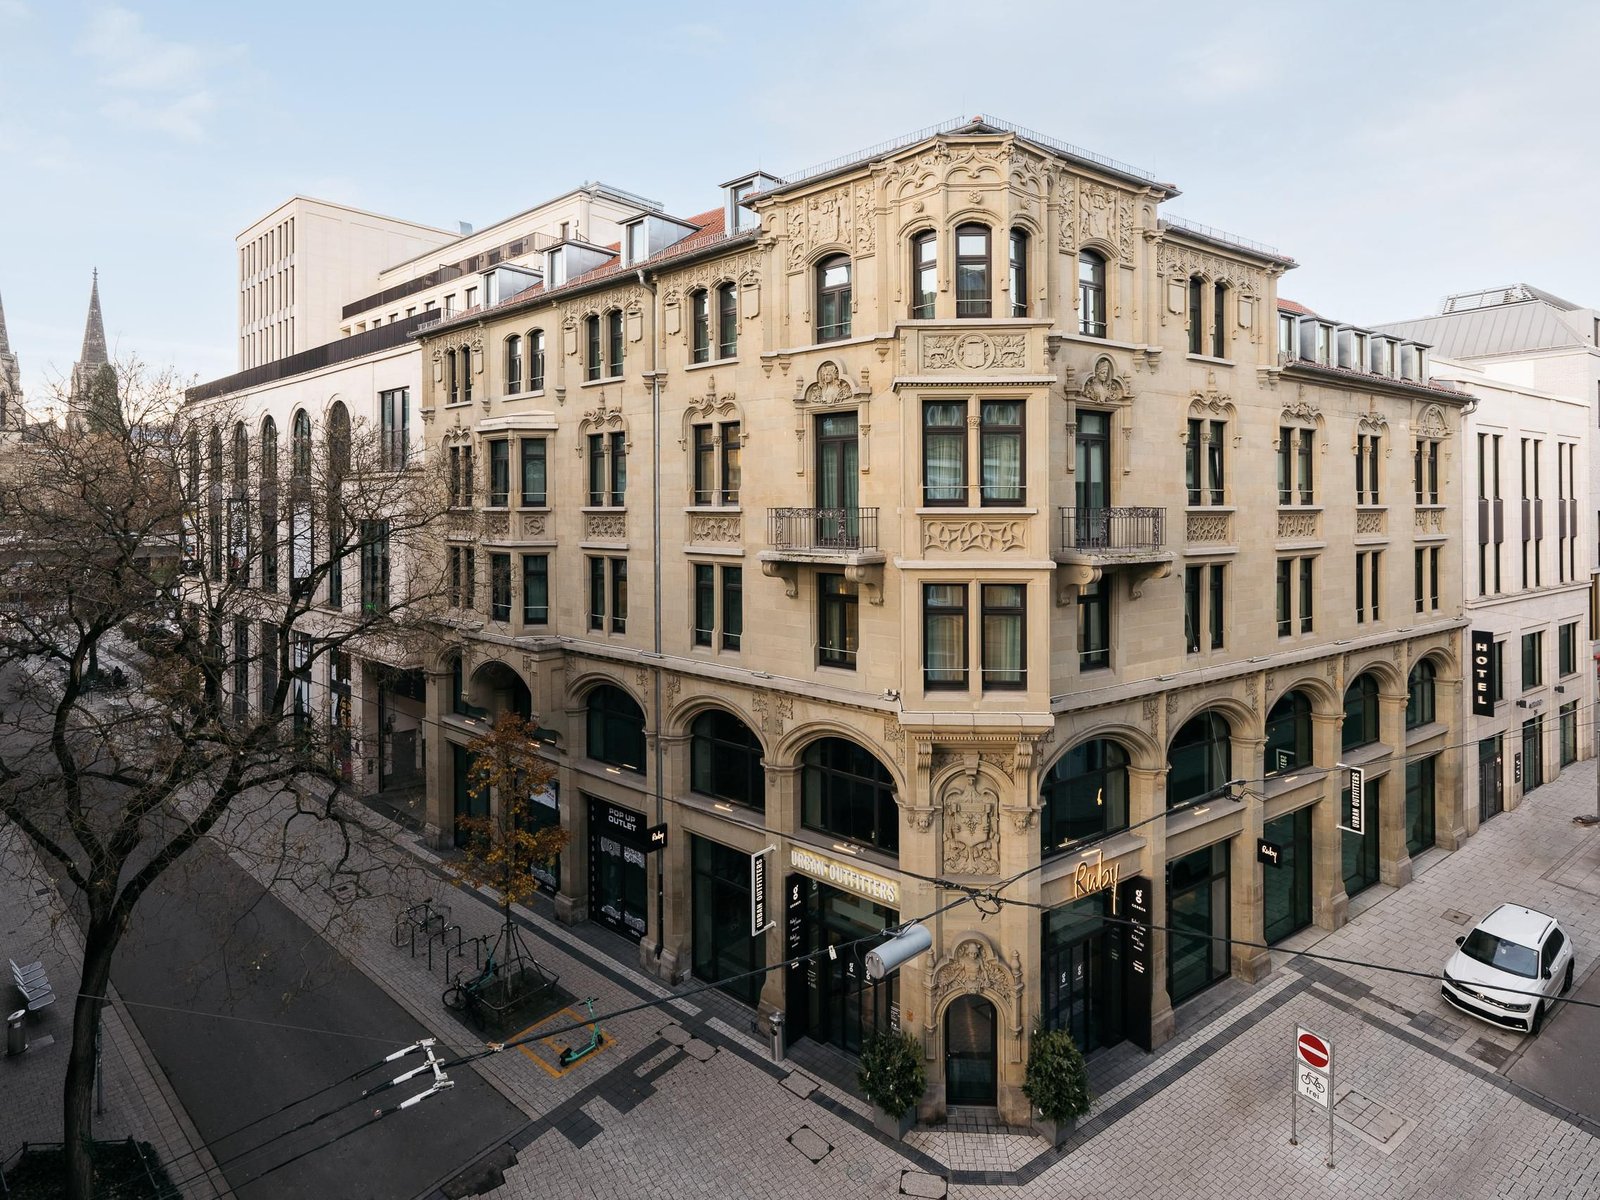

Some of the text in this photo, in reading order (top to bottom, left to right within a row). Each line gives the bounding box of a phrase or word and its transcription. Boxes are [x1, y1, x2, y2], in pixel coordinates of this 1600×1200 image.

[1475, 642, 1488, 705] HOTEL
[609, 808, 636, 822] POP UP
[1351, 772, 1360, 828] URBAN OUTFITTERS
[608, 815, 637, 832] OUTLET
[651, 831, 665, 843] Ruby
[1261, 845, 1278, 864] Ruby
[756, 858, 764, 929] URBAN OUTFITTERS
[791, 850, 896, 903] URBAN OUTFITTERS
[1074, 850, 1120, 915] Ruby
[1306, 1087, 1320, 1099] frei
